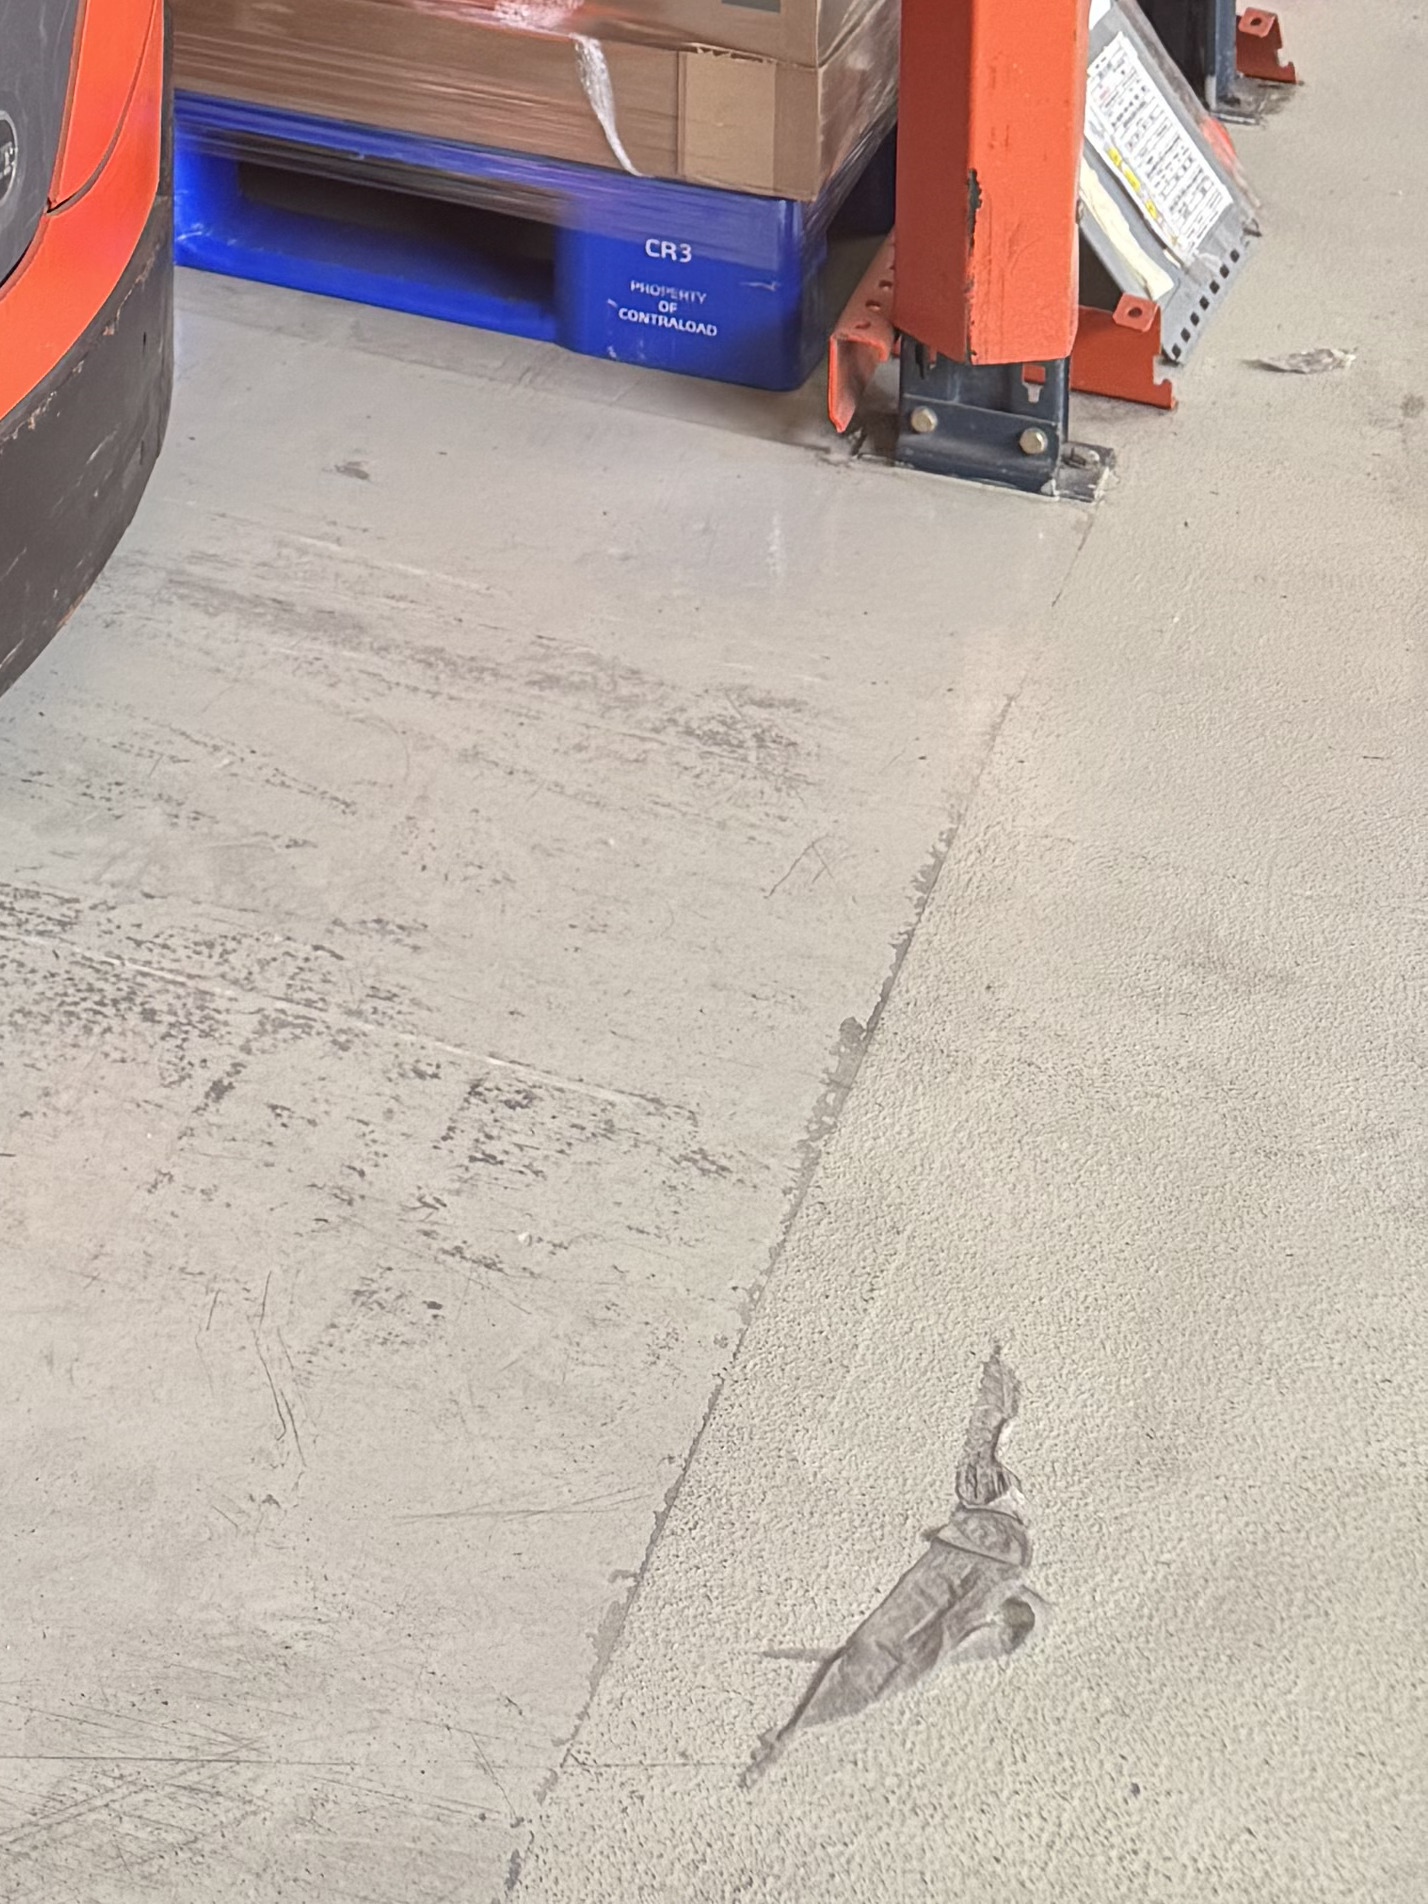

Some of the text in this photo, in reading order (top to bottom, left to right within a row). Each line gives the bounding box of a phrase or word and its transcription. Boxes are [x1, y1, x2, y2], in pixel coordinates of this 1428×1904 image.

[645, 239, 692, 263] CR3
[630, 280, 707, 304] PROPERTY
[658, 300, 678, 313] OF
[619, 308, 718, 337] CONTRALOAD
